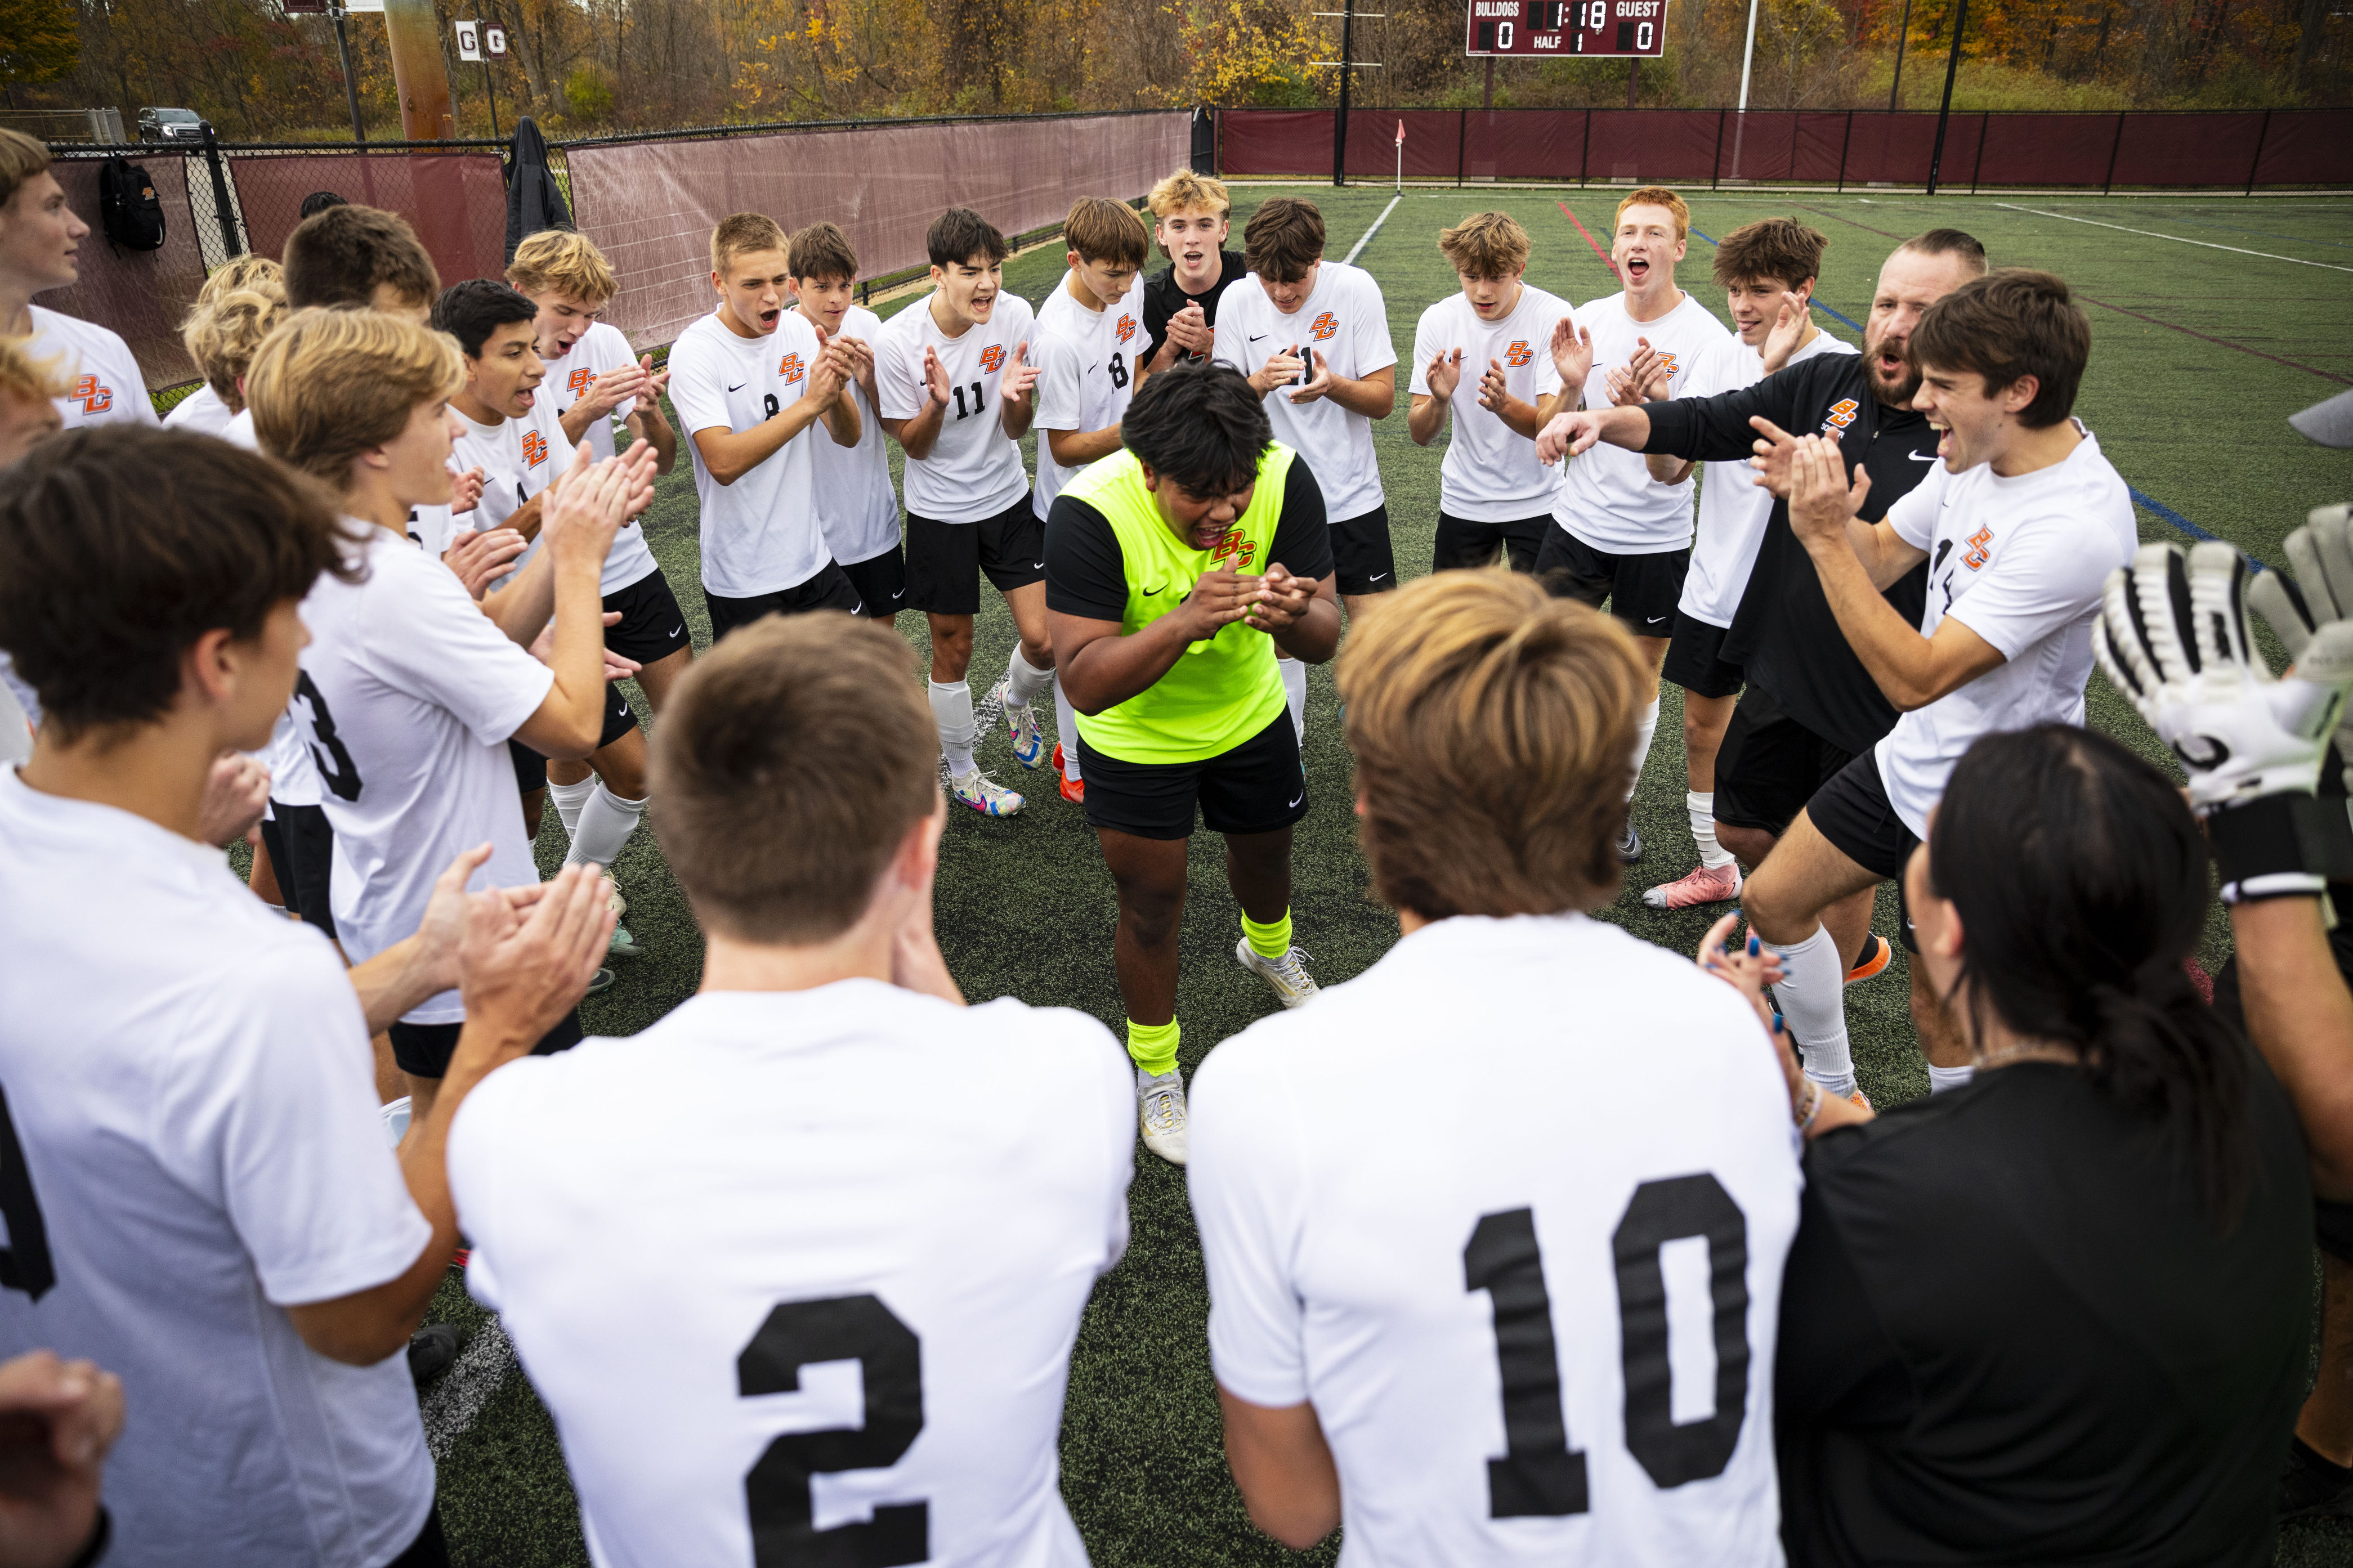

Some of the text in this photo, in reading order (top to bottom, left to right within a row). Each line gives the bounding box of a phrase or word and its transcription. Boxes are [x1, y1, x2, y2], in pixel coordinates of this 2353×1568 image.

[1475, 1, 1519, 17] BULLDOGS
[1616, 1, 1660, 17] GUEST
[460, 30, 478, 53] G
[486, 29, 506, 53] G
[1497, 21, 1514, 49] 0
[1533, 33, 1583, 52] HALF 1
[1636, 22, 1653, 50] 0
[1115, 313, 1137, 345] BC
[1308, 311, 1339, 342] BC
[779, 352, 805, 386] BC
[978, 343, 1007, 375] BC
[1279, 347, 1313, 386] 1
[1504, 340, 1533, 368] BC
[68, 373, 114, 416] BC
[952, 381, 986, 421] 11
[1826, 397, 1860, 428] BC
[1820, 423, 1845, 439] SOR
[521, 429, 549, 471] BC
[1210, 528, 1257, 569] BC
[1959, 523, 1994, 572] BC
[1462, 1171, 1751, 1518] 10
[736, 1293, 931, 1568] 2
